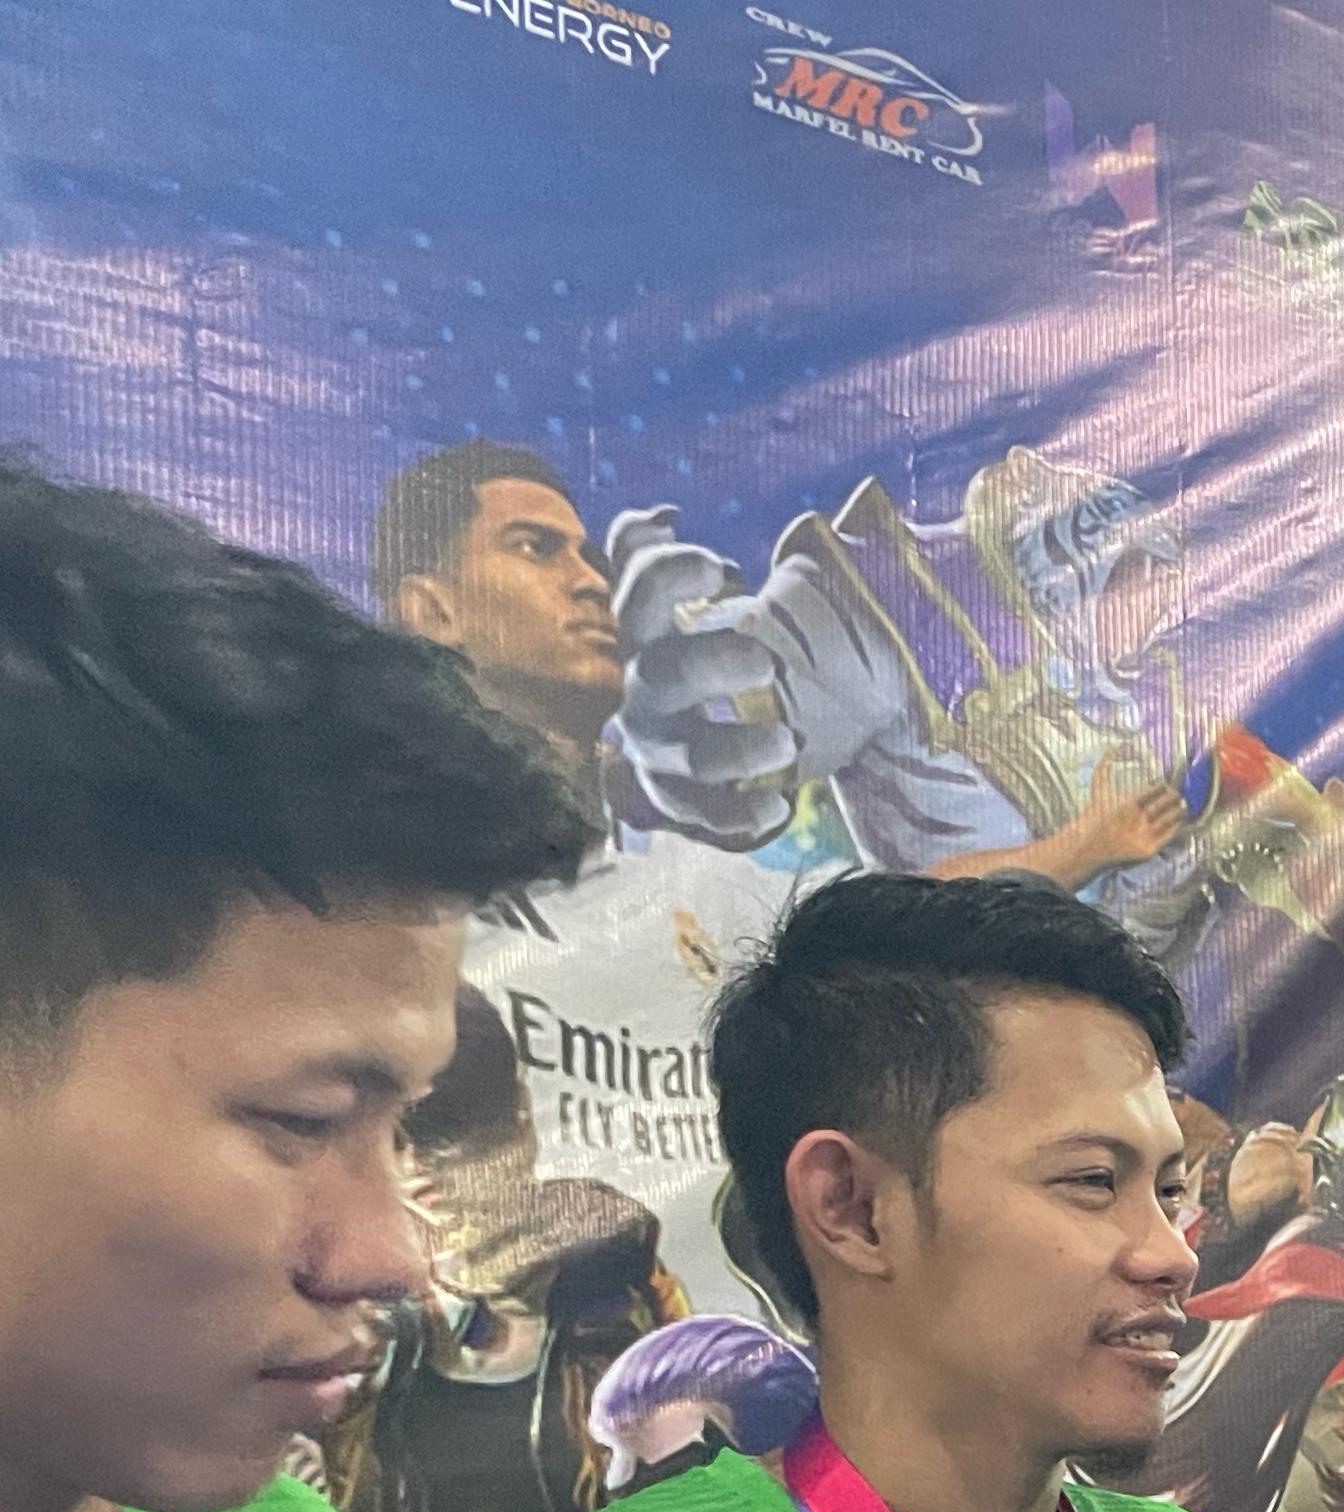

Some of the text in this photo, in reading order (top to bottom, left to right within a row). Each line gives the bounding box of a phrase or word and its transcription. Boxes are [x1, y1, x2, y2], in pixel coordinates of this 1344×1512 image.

[451, 0, 671, 76] NERGY
[745, 6, 833, 47] CREW
[775, 55, 930, 138] MRC
[861, 129, 925, 165] RENT
[931, 155, 984, 186] CAR
[559, 1091, 613, 1149] FLY
